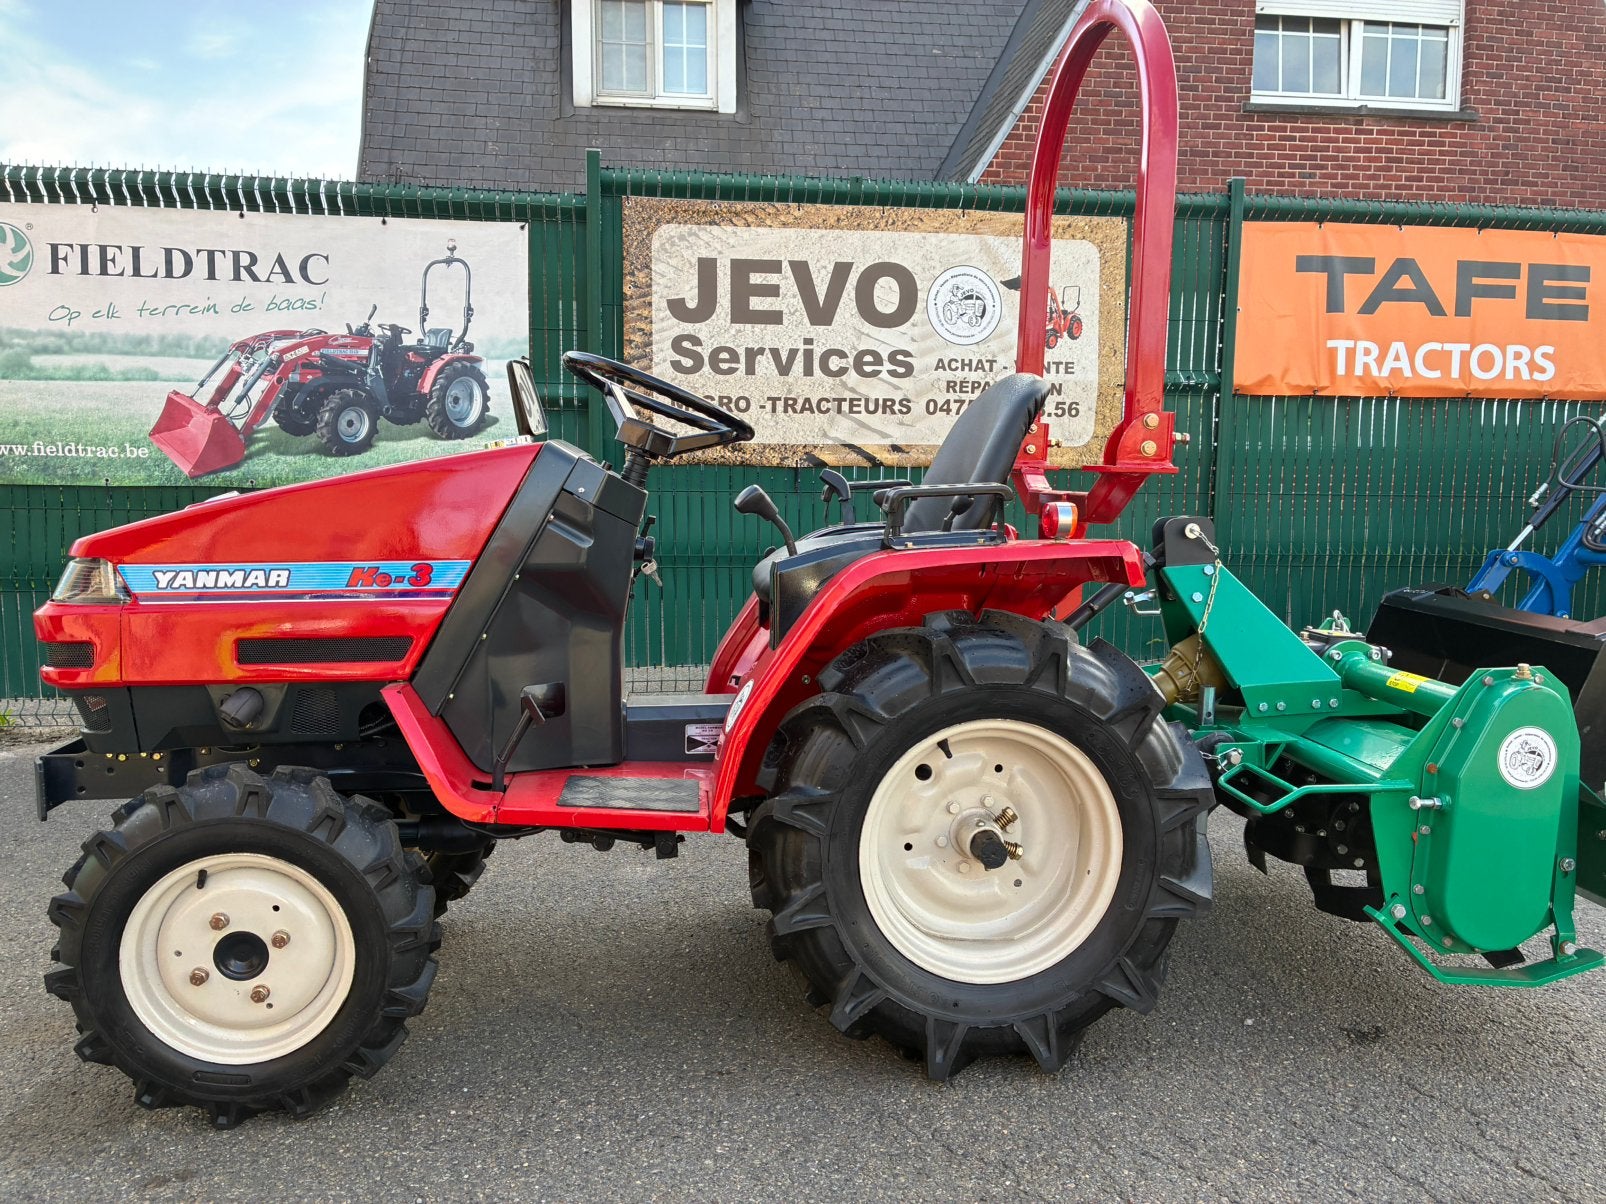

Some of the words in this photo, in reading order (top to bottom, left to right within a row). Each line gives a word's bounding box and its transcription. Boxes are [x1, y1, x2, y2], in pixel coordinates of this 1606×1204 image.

[46, 241, 331, 286] FIELDTRAC
[48, 304, 81, 326] Op
[92, 302, 122, 319] elk
[136, 296, 219, 317] terrein
[230, 296, 256, 313] de
[265, 291, 327, 312] baas!
[666, 256, 919, 328] JEVO
[960, 288, 975, 297] JEVO
[1295, 254, 1591, 322] TAFE
[669, 332, 915, 379] Services
[934, 357, 997, 373] ACHAT
[1326, 339, 1556, 382] TRACTORS
[153, 569, 291, 589] YANMAR
[345, 562, 434, 588] Ke-3
